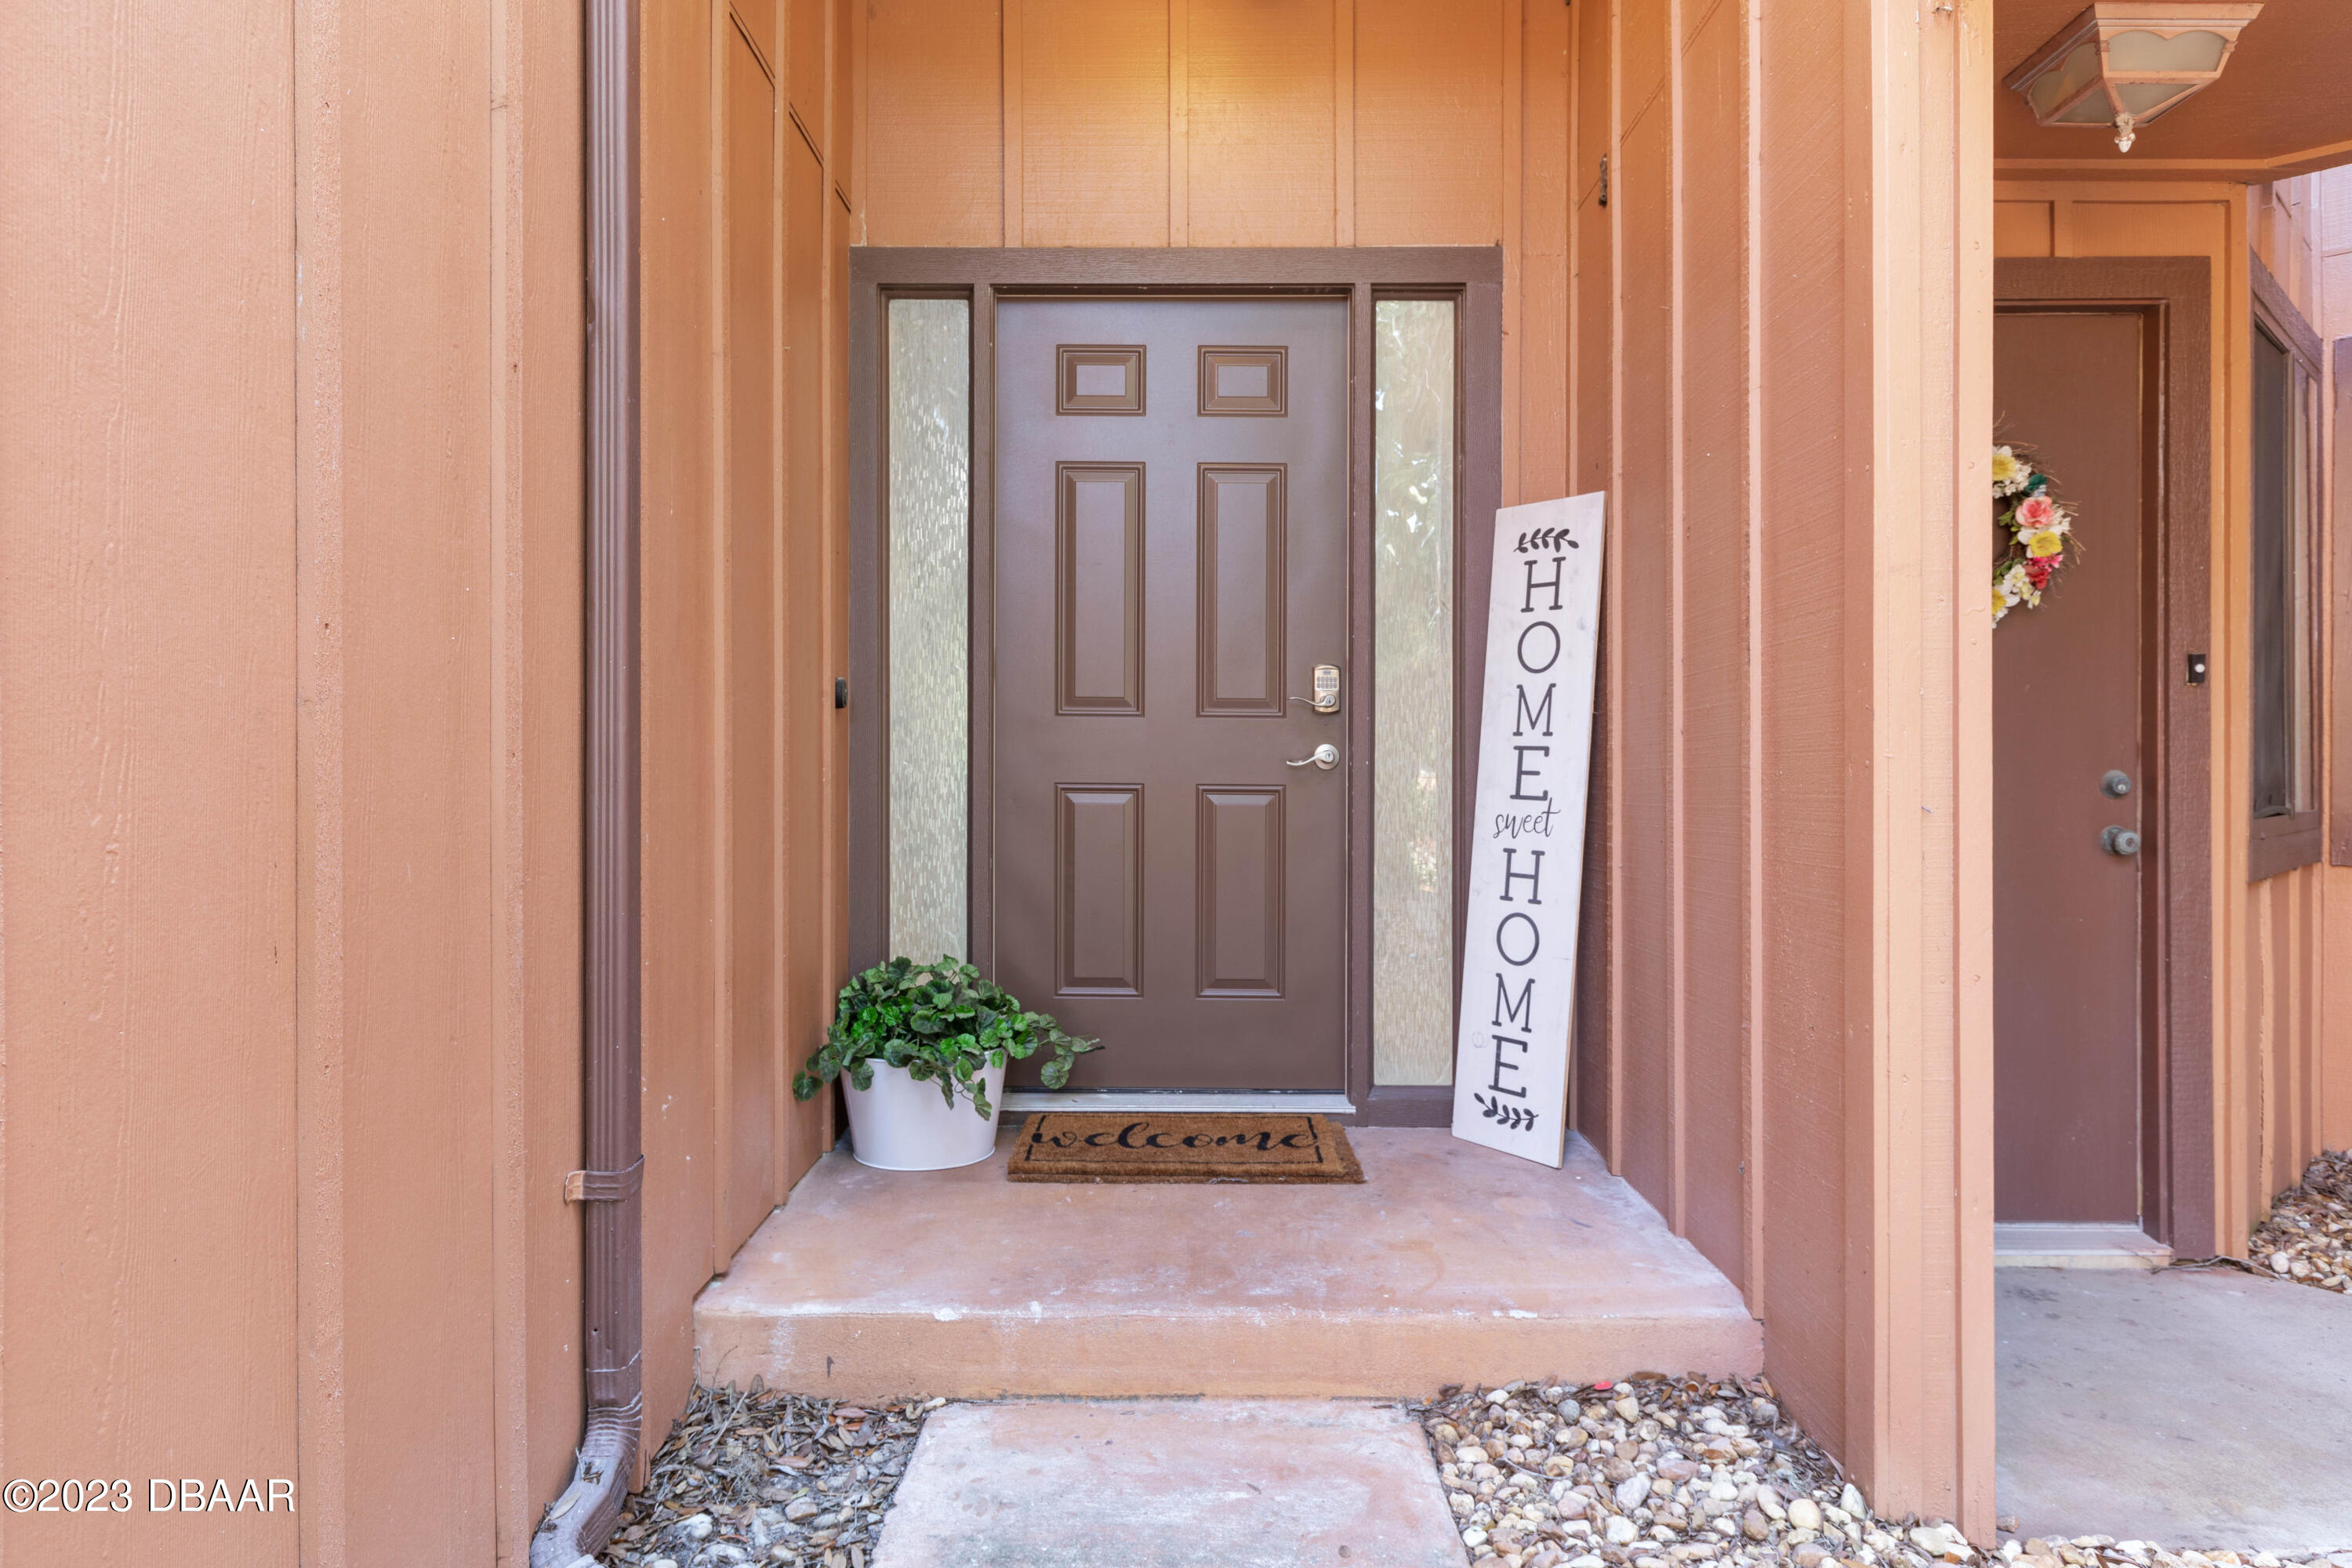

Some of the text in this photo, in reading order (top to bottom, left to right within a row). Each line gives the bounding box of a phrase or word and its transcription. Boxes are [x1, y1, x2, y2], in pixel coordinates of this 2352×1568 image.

[1509, 556, 1566, 801] HOME
[1492, 797, 1562, 840] sweet
[1487, 848, 1546, 1098] HOME
[1031, 1121, 1318, 1151] welcome
